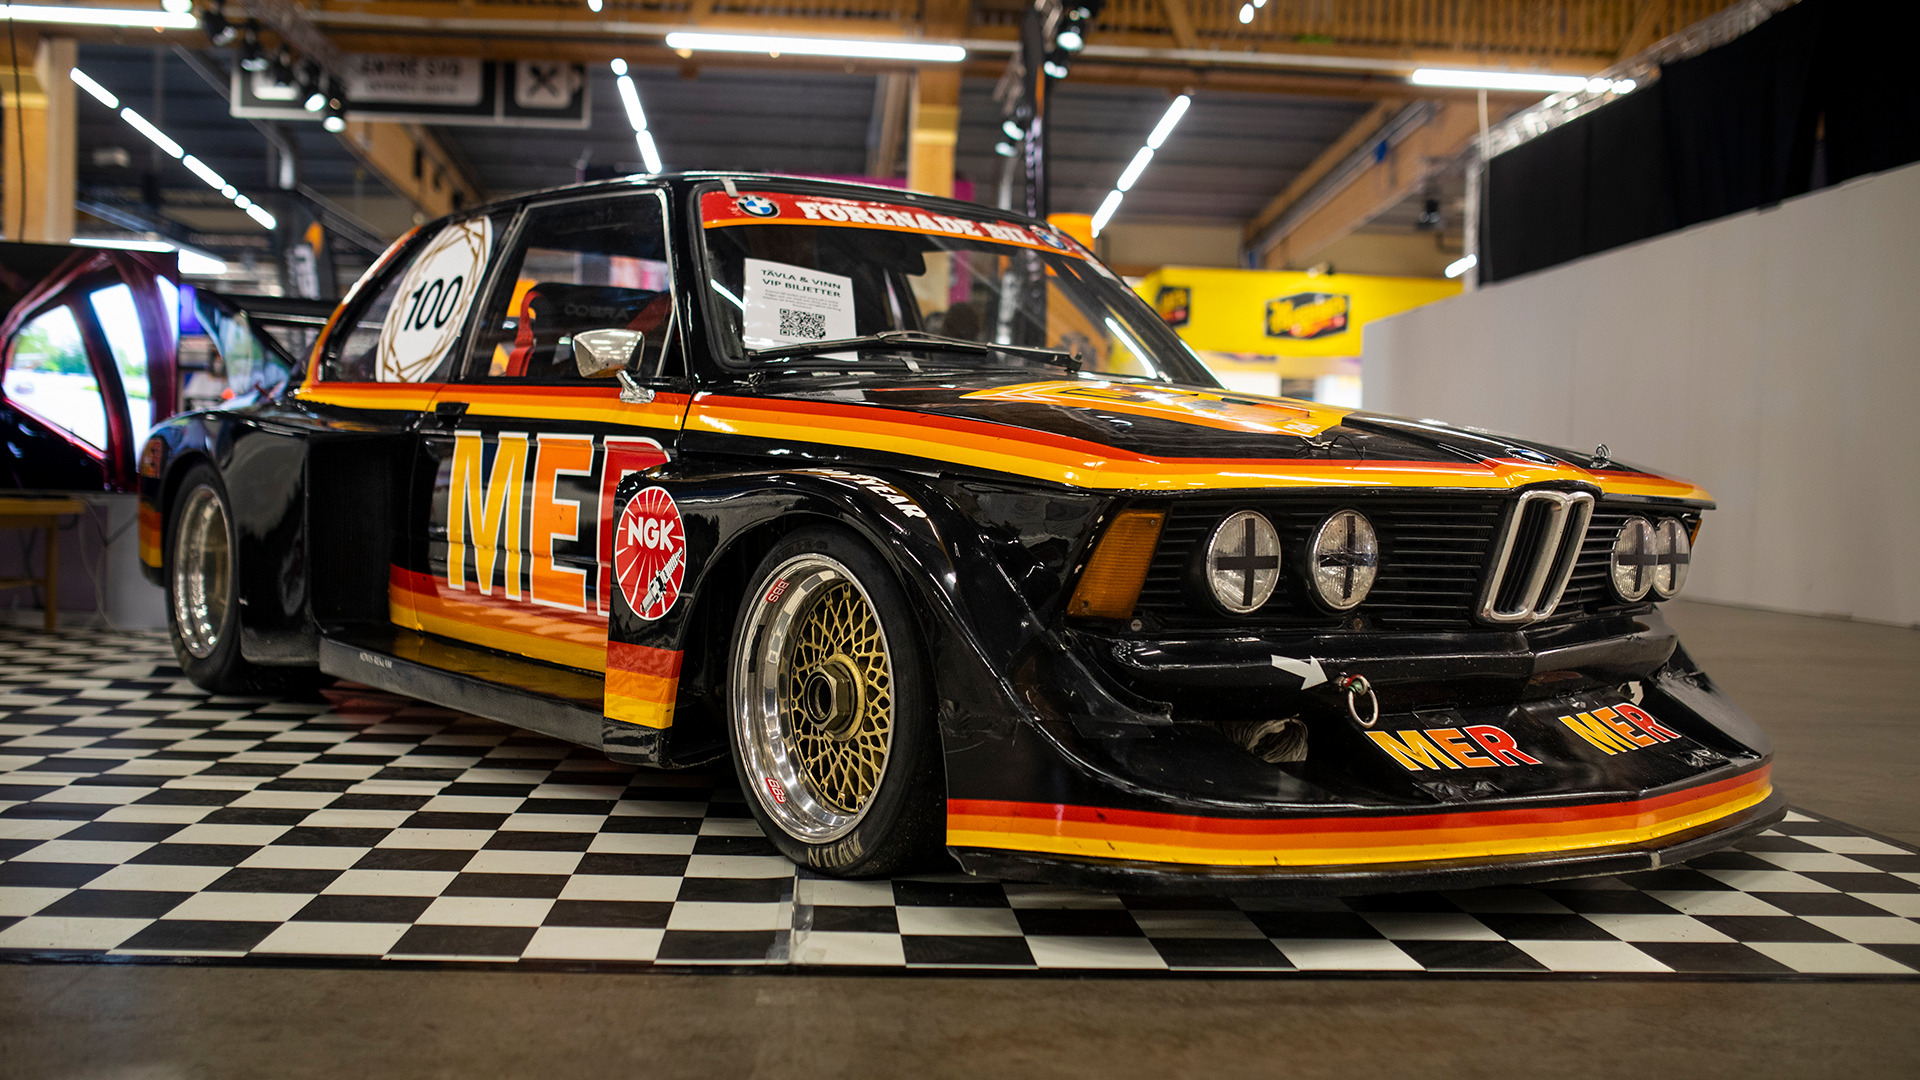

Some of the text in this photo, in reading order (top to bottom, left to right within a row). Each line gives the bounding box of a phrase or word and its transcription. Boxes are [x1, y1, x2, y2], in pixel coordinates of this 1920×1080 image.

[761, 269, 797, 281] TÄVLA
[812, 279, 841, 290] VINN
[762, 279, 841, 298] VIP BILJETTER
[403, 275, 463, 331] 100
[627, 516, 676, 553] NGK
[767, 580, 790, 603] BBS
[1558, 702, 1682, 756] MER
[1364, 724, 1543, 771] MER
[767, 778, 786, 803] BBS
